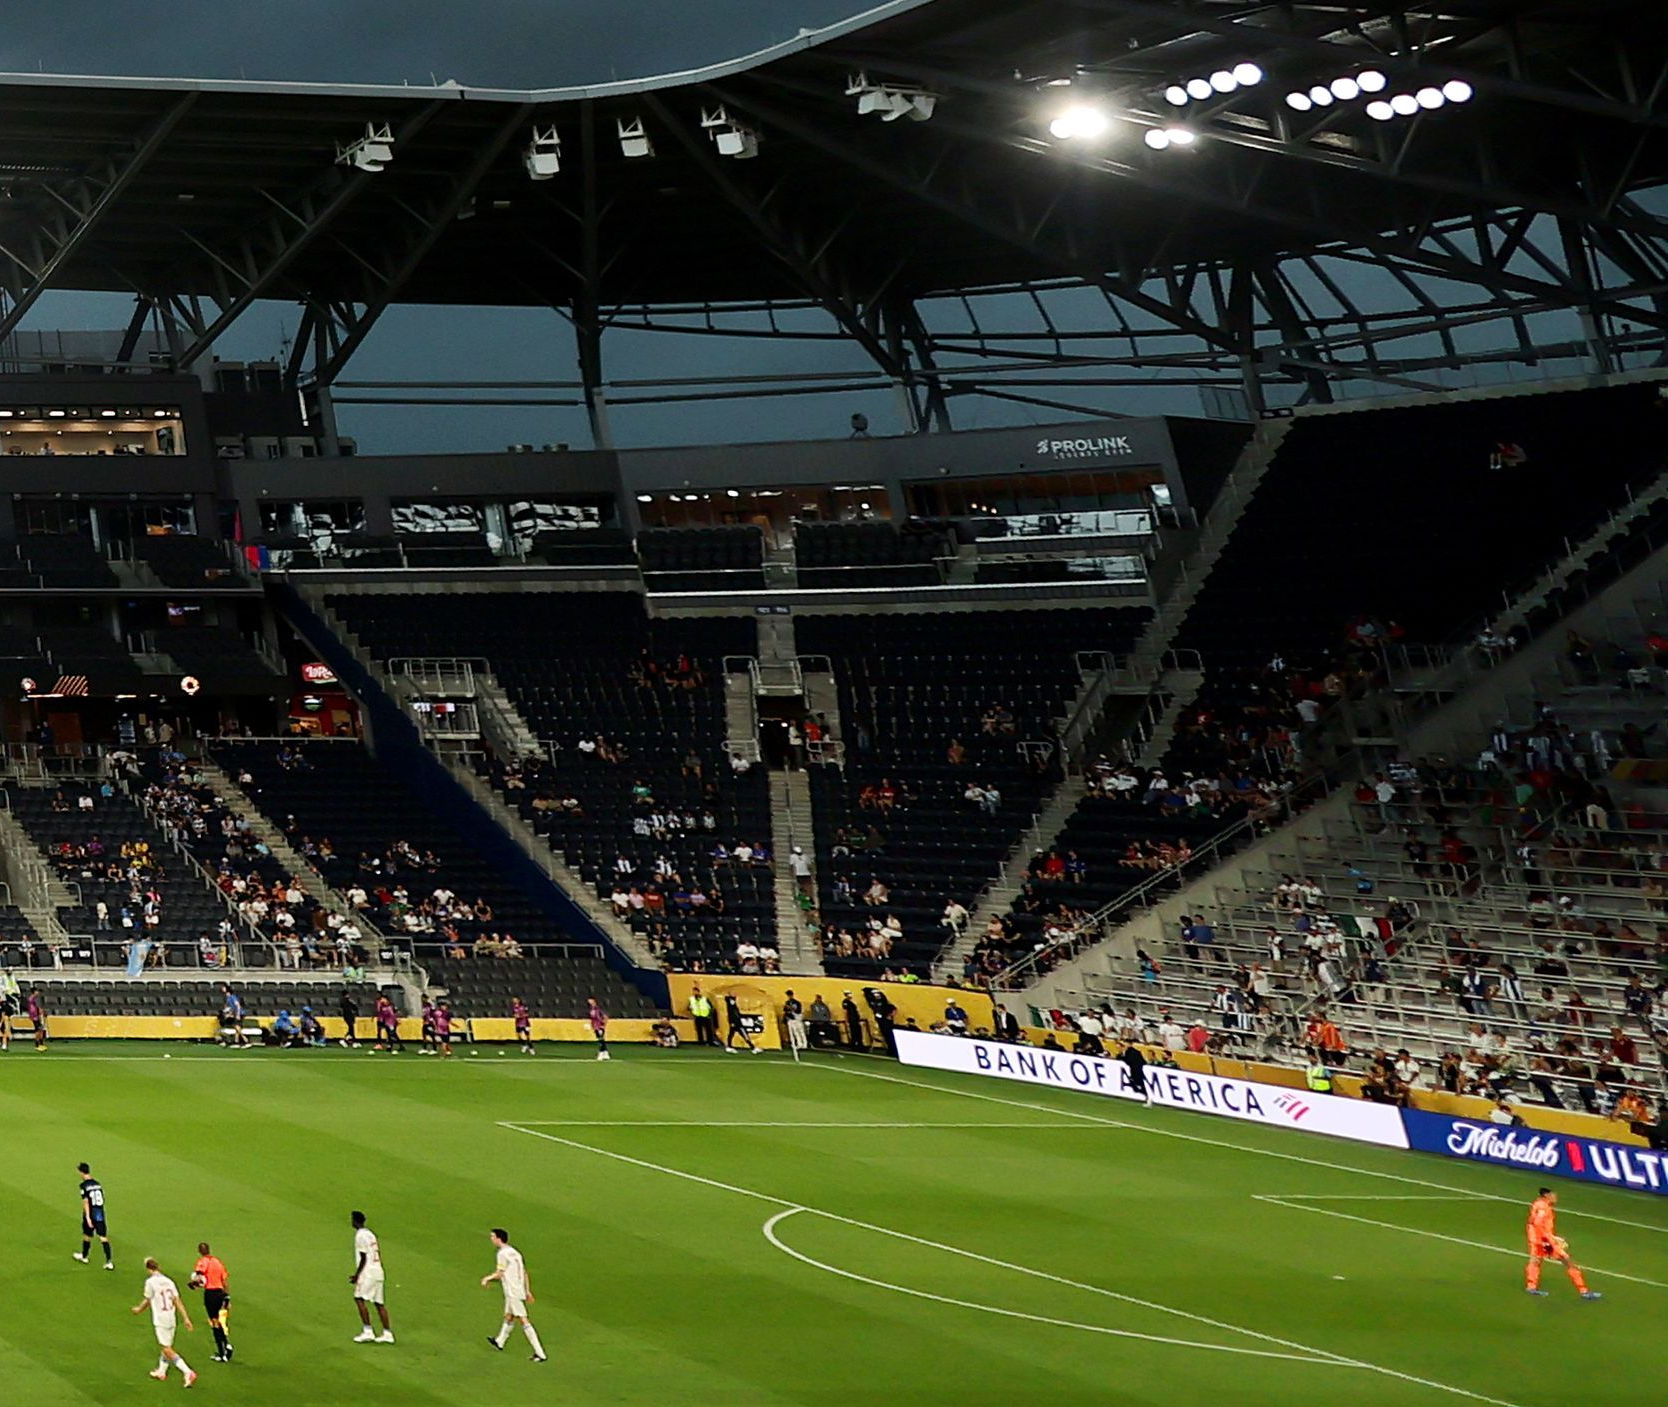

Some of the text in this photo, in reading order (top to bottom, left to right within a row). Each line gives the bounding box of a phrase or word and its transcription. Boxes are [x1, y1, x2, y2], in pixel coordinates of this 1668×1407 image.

[1050, 436, 1130, 453] PROLINK
[975, 1045, 1265, 1117] BANK OF AMERICA
[1447, 1121, 1668, 1196] Michelob ULT
